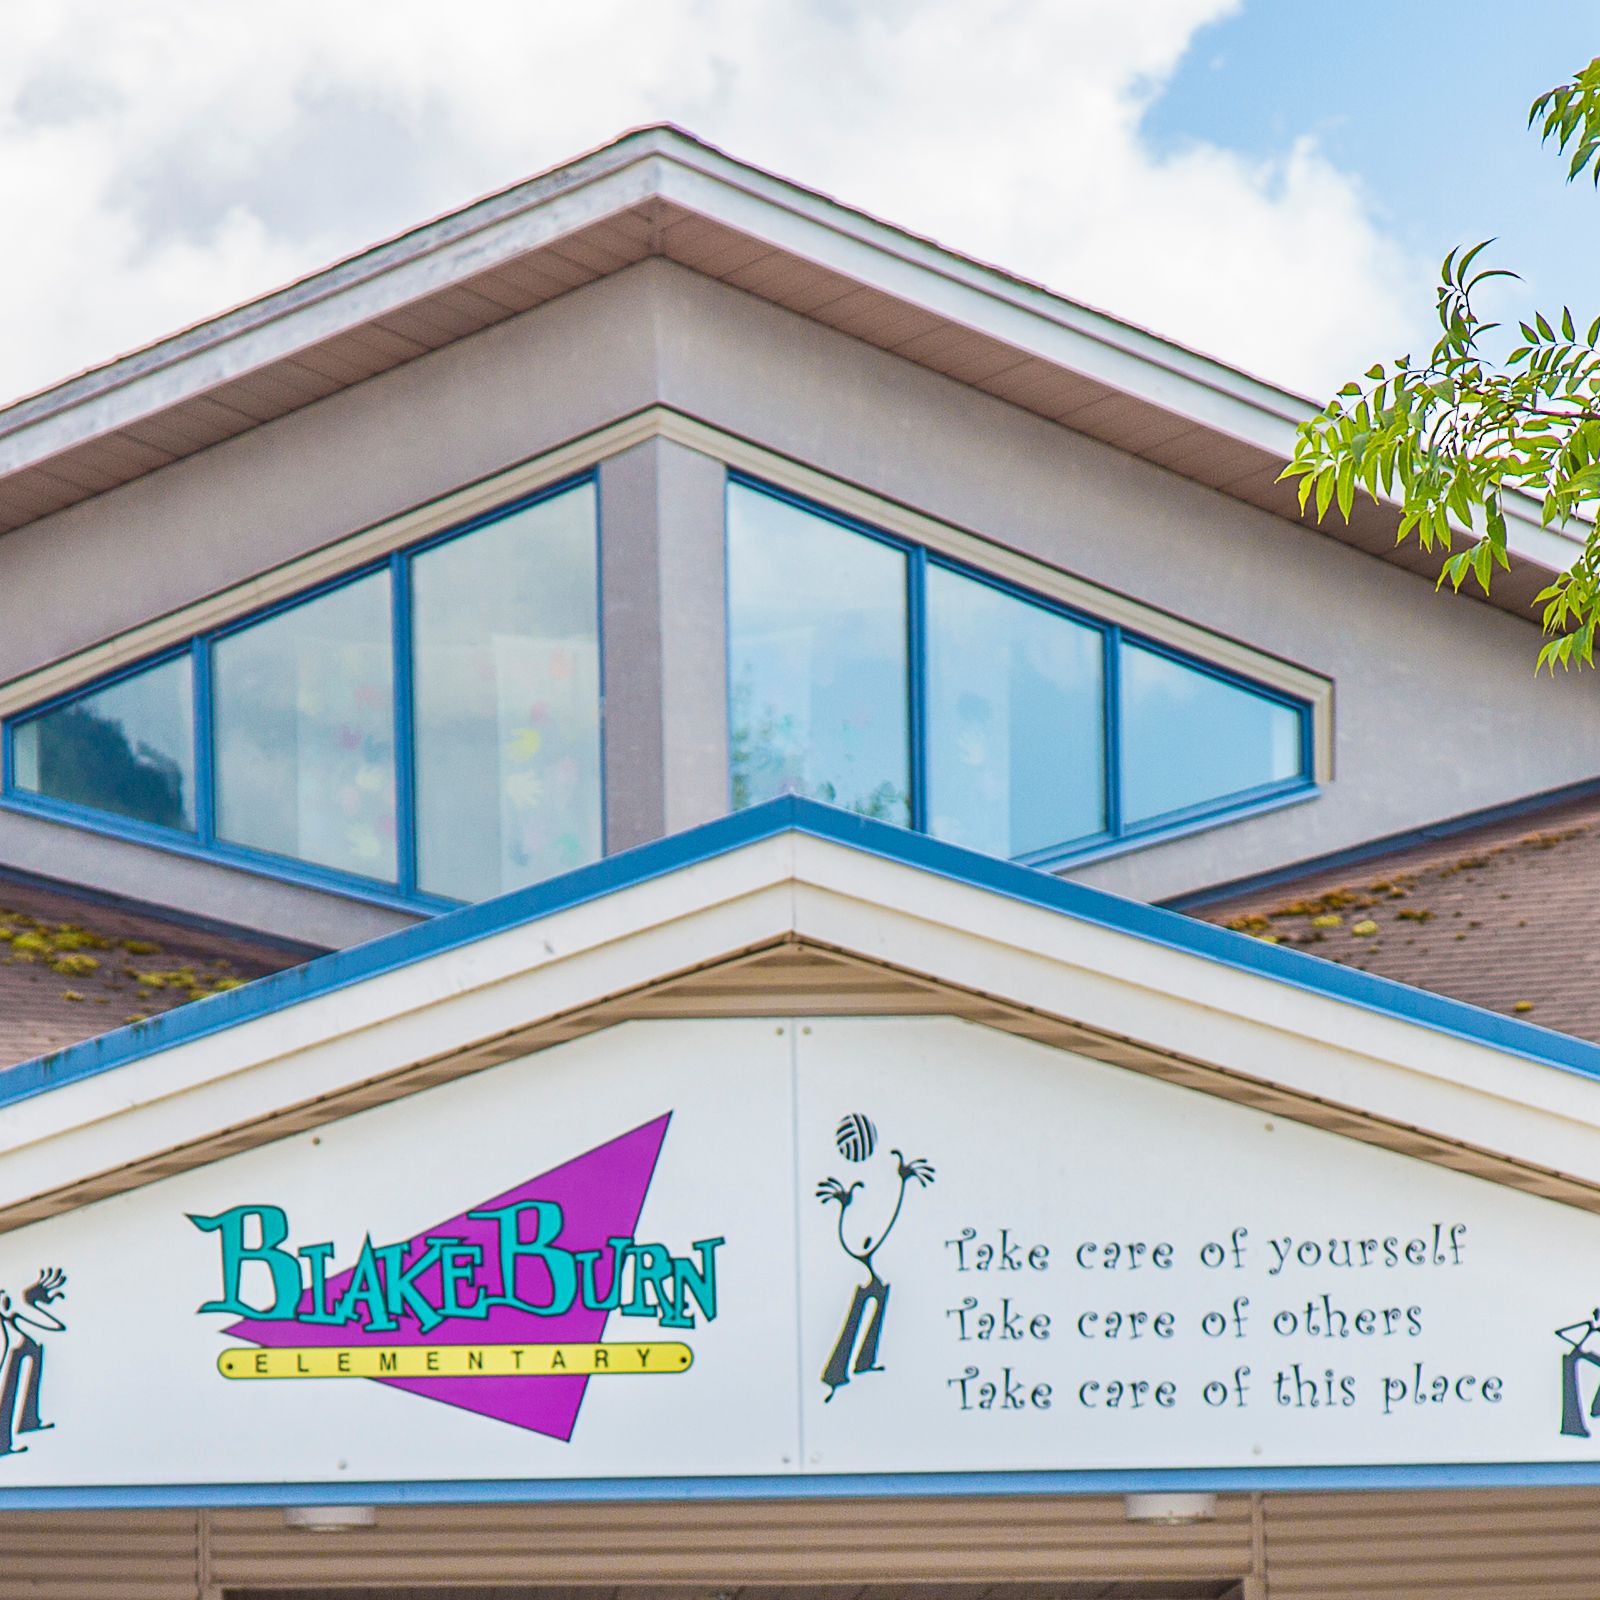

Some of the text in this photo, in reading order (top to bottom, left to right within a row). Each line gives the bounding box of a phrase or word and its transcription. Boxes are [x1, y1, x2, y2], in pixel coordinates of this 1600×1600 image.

[944, 1223, 1467, 1276] Take care of yourself
[946, 1294, 1422, 1341] Take care of others
[254, 1348, 654, 1373] ELEMENTARY
[947, 1362, 1503, 1415] Take care of this place
